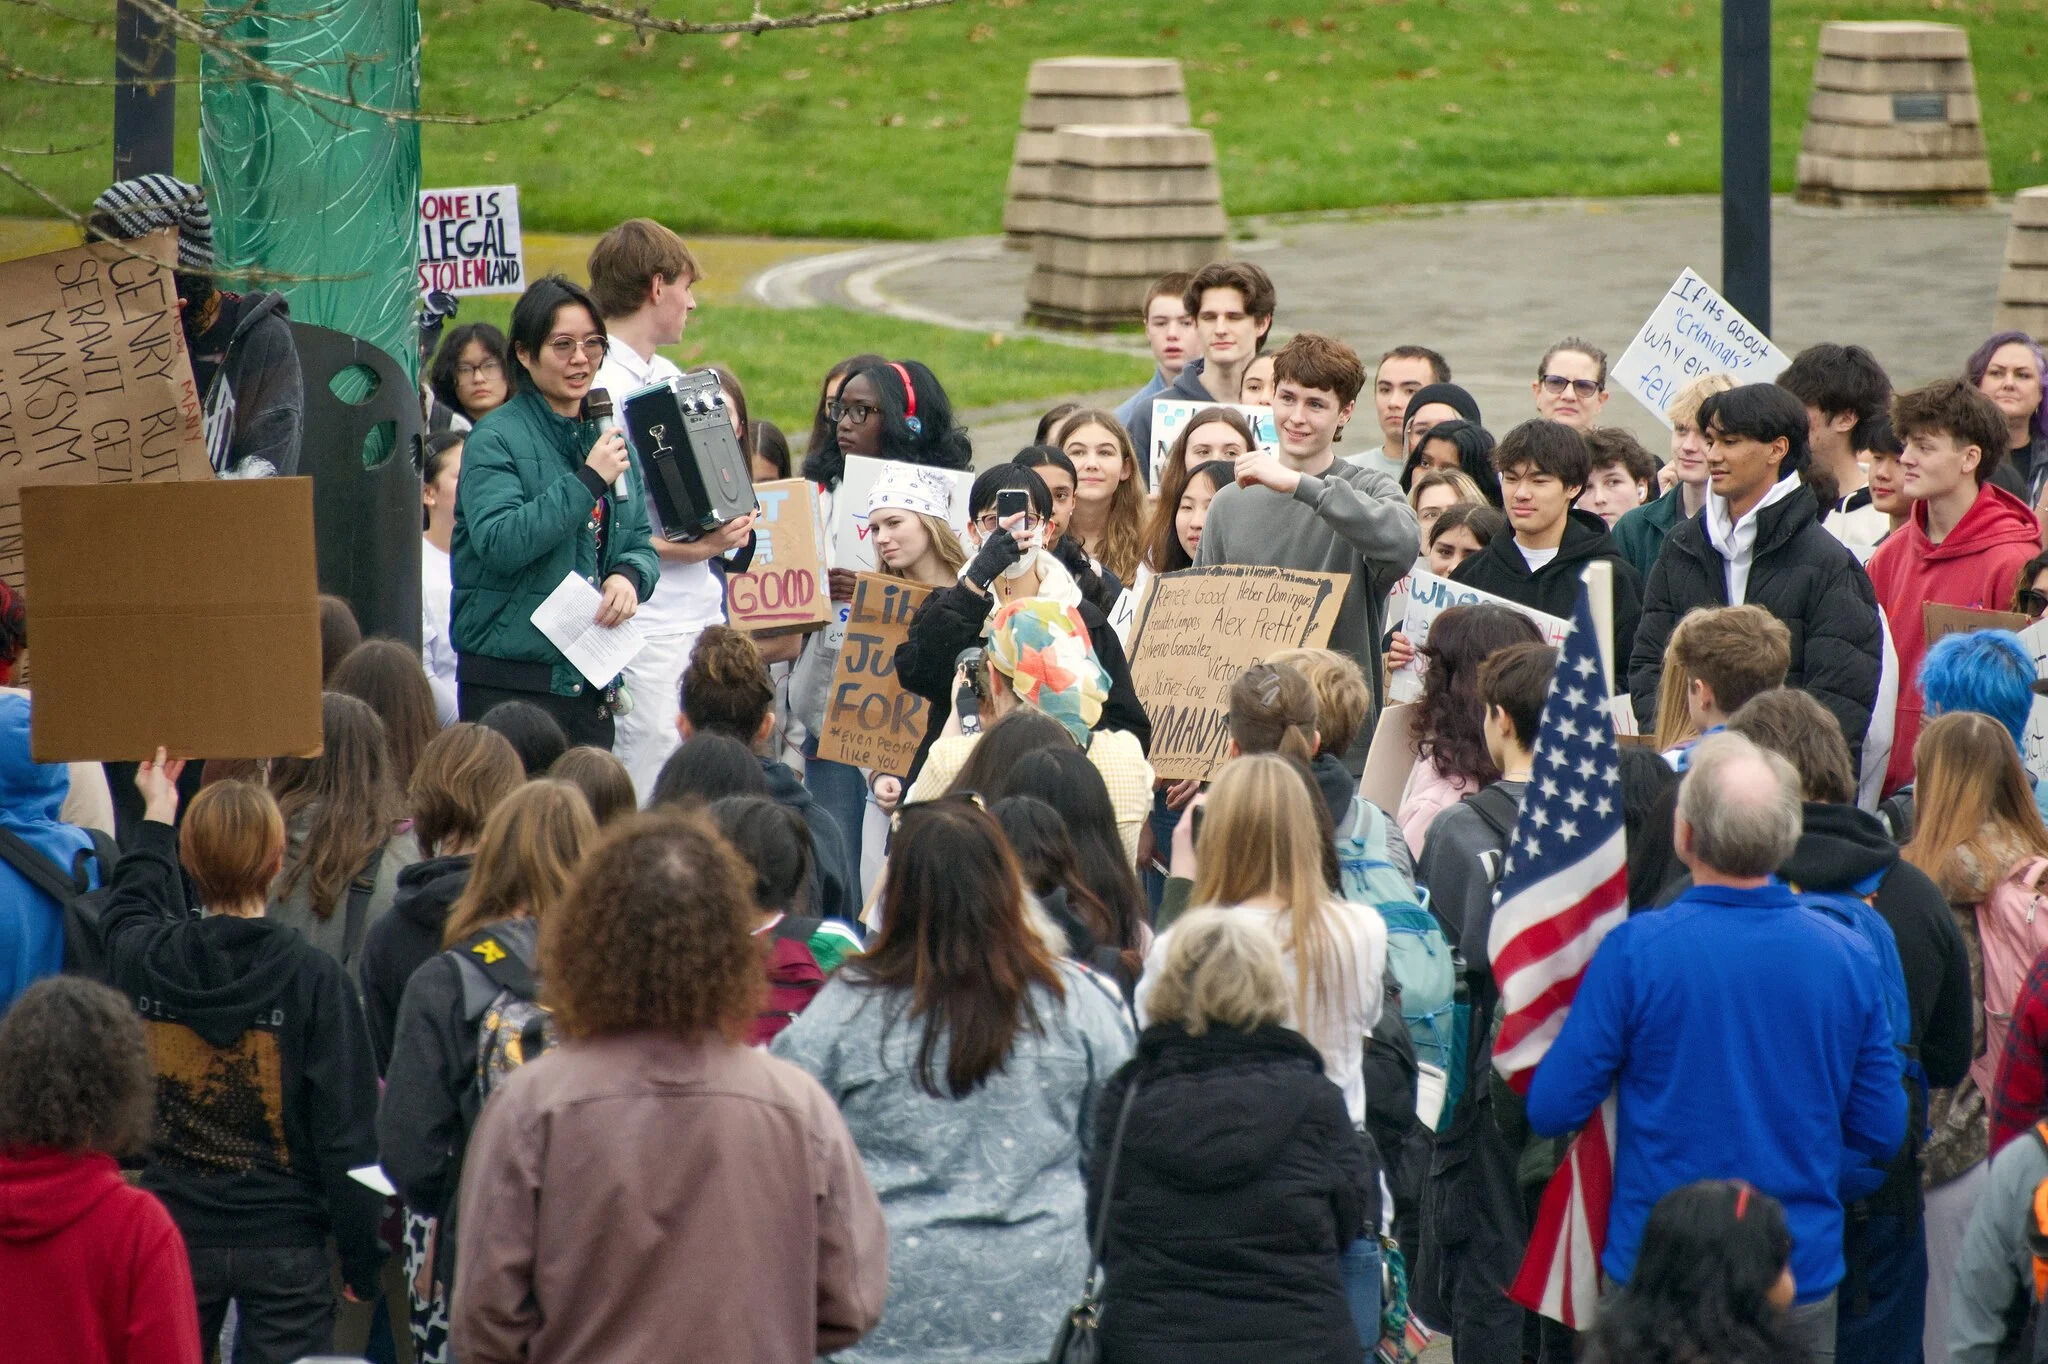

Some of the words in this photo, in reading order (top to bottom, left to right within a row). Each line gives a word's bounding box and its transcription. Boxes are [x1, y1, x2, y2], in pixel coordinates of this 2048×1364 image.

[421, 195, 471, 222] ONE
[476, 192, 500, 218] IS
[420, 218, 517, 263] LEGAL
[54, 259, 125, 396] SERAWIT
[1671, 277, 1708, 303] If
[1727, 319, 1770, 361] about
[6, 310, 87, 470] MAKSYM
[108, 255, 174, 381] GENRY
[141, 406, 181, 481] RUI
[181, 379, 202, 442] MANY
[728, 568, 815, 615] GOOD
[1195, 580, 1230, 606] Good
[1237, 580, 1263, 601] Heber
[1211, 607, 1246, 637] Alex
[1251, 607, 1302, 644] Pretti
[845, 632, 896, 678] Ju
[830, 682, 923, 737] FOR
